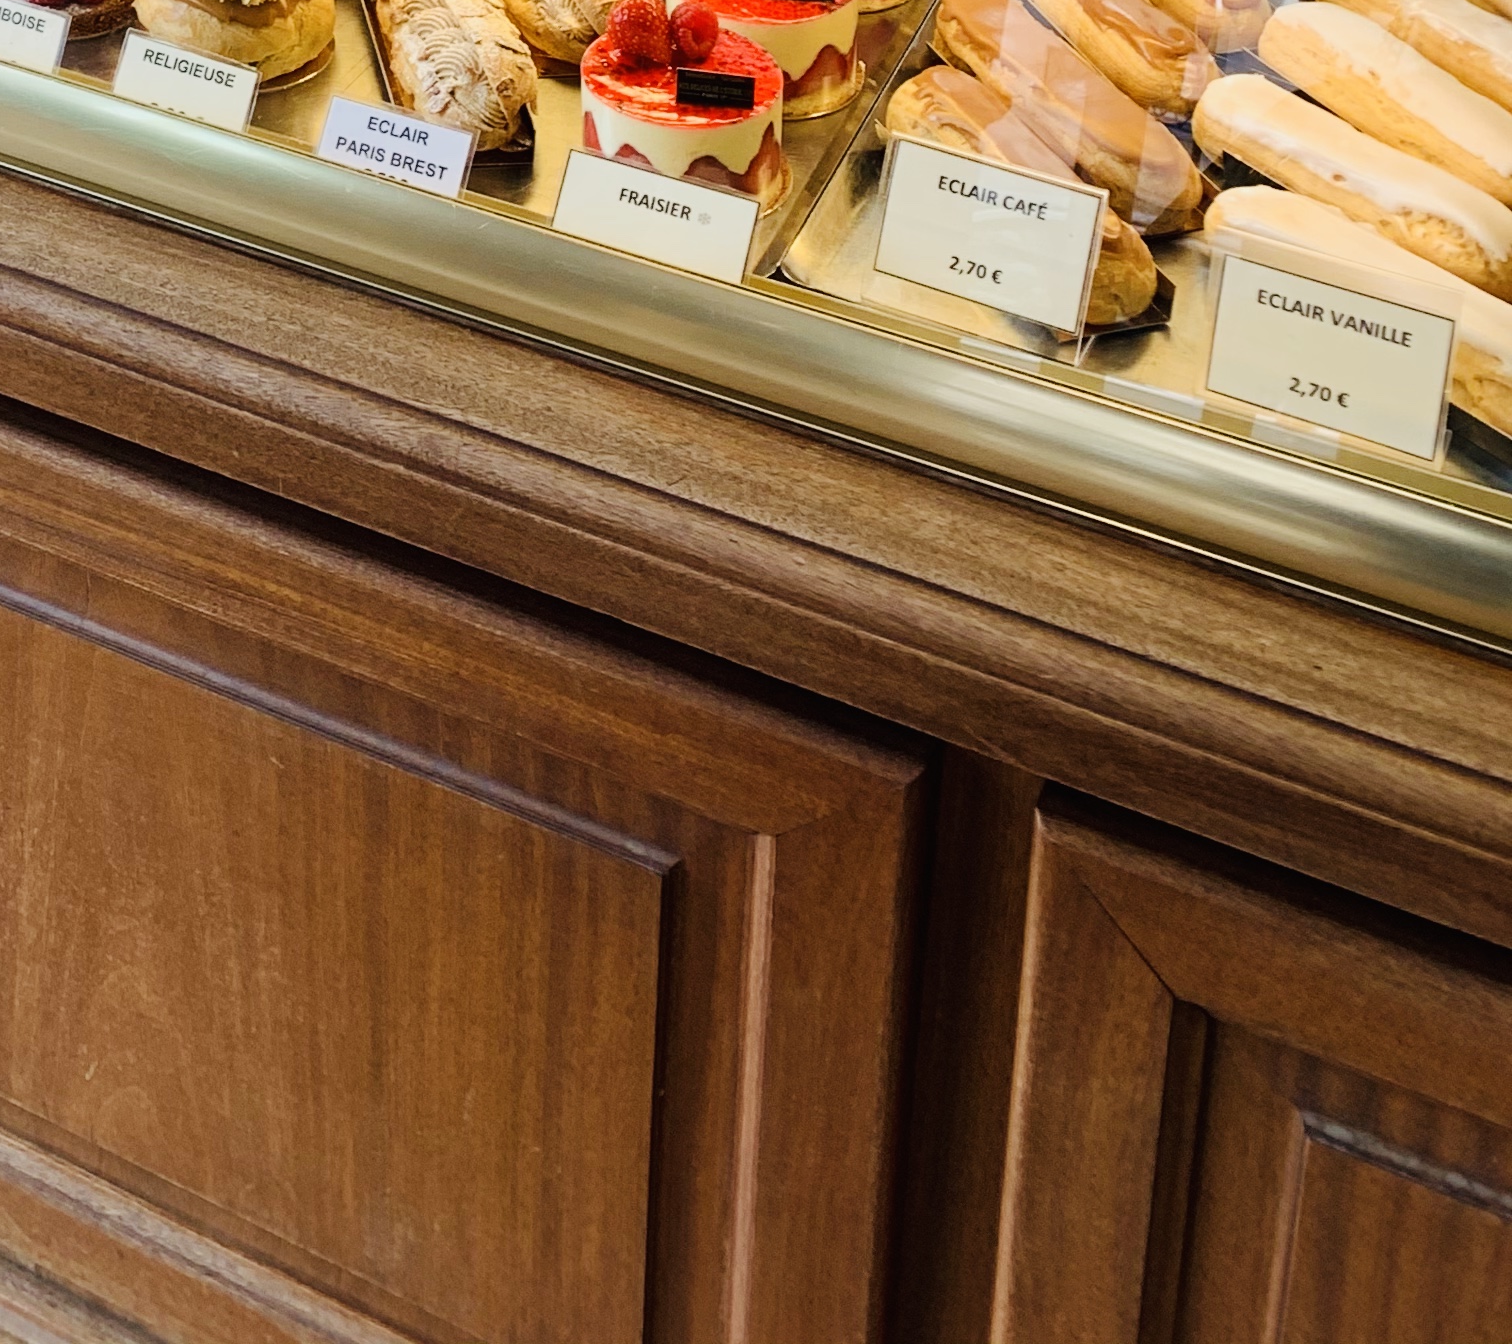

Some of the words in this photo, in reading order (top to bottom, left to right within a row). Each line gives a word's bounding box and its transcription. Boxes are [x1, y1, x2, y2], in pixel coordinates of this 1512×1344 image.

[142, 48, 237, 88] RELIGIEUSE
[367, 116, 429, 146] ECLAIR
[335, 136, 387, 164] PARIS
[390, 152, 448, 182] BREST
[619, 187, 692, 222] FRAISIER
[938, 175, 997, 206] ECLAIR
[1002, 195, 1048, 221] CAFÉ
[949, 256, 987, 279] 2,70
[991, 269, 1003, 285] €
[1257, 289, 1325, 322] ECLAIR
[1331, 310, 1413, 348] VANILLE
[1289, 377, 1332, 402] 2,70
[1337, 392, 1350, 408] €
